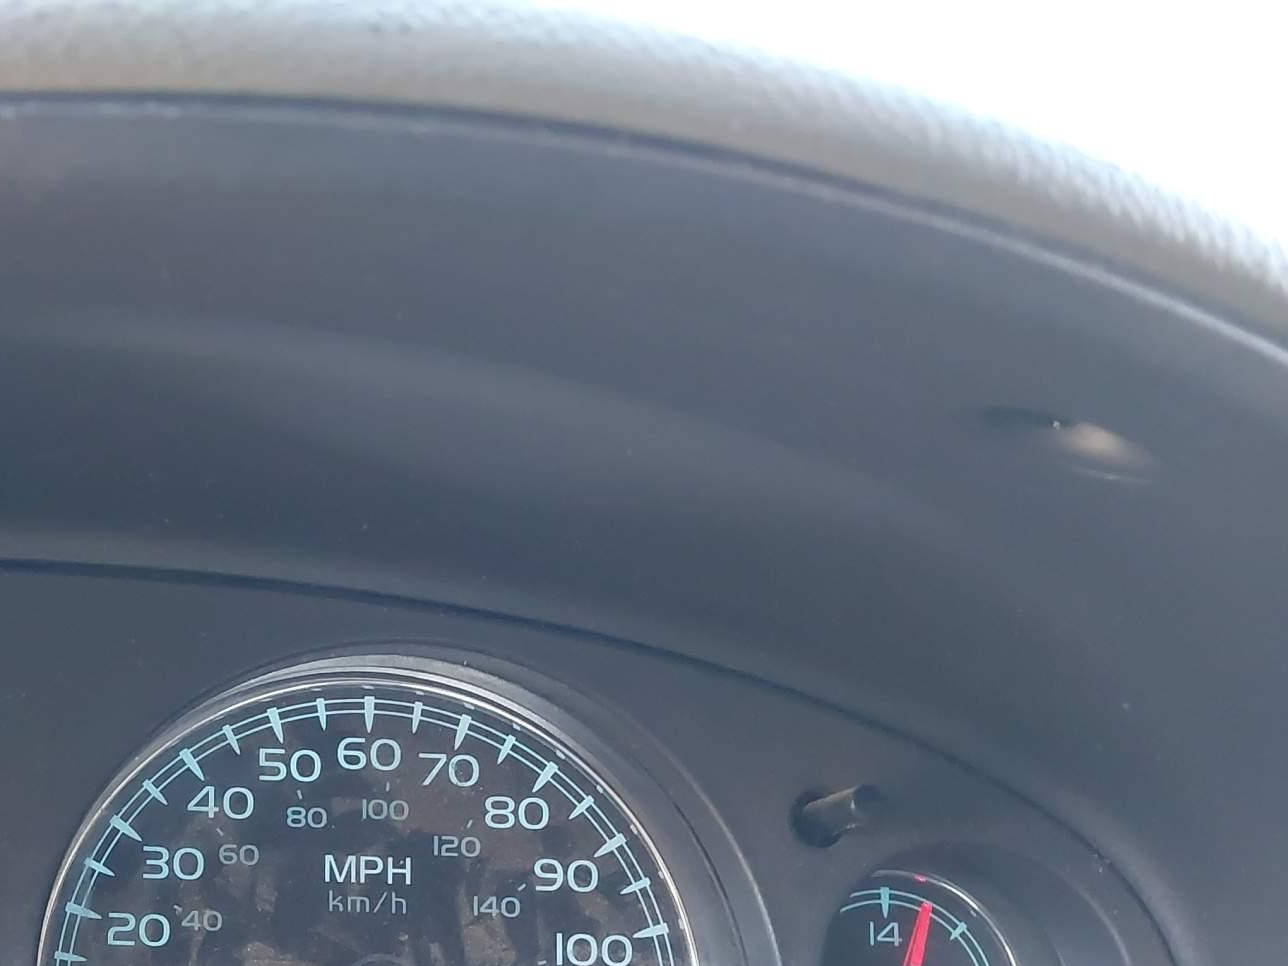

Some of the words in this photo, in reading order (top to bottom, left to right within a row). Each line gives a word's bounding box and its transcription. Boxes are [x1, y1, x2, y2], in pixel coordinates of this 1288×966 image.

[258, 748, 321, 782] 50
[336, 737, 401, 771] 60
[418, 752, 480, 787] 70
[187, 786, 255, 820] 40
[286, 807, 328, 828] 80
[361, 799, 410, 821] 100
[484, 796, 550, 830] 80
[218, 844, 260, 866] 60
[433, 836, 481, 857] 120
[142, 846, 205, 880] 30
[323, 854, 412, 885] MPH
[533, 858, 599, 893] 90
[328, 891, 407, 914] km/h
[473, 896, 521, 918] 140
[107, 912, 170, 947] 20
[181, 910, 223, 932] 40
[869, 922, 902, 946] 14
